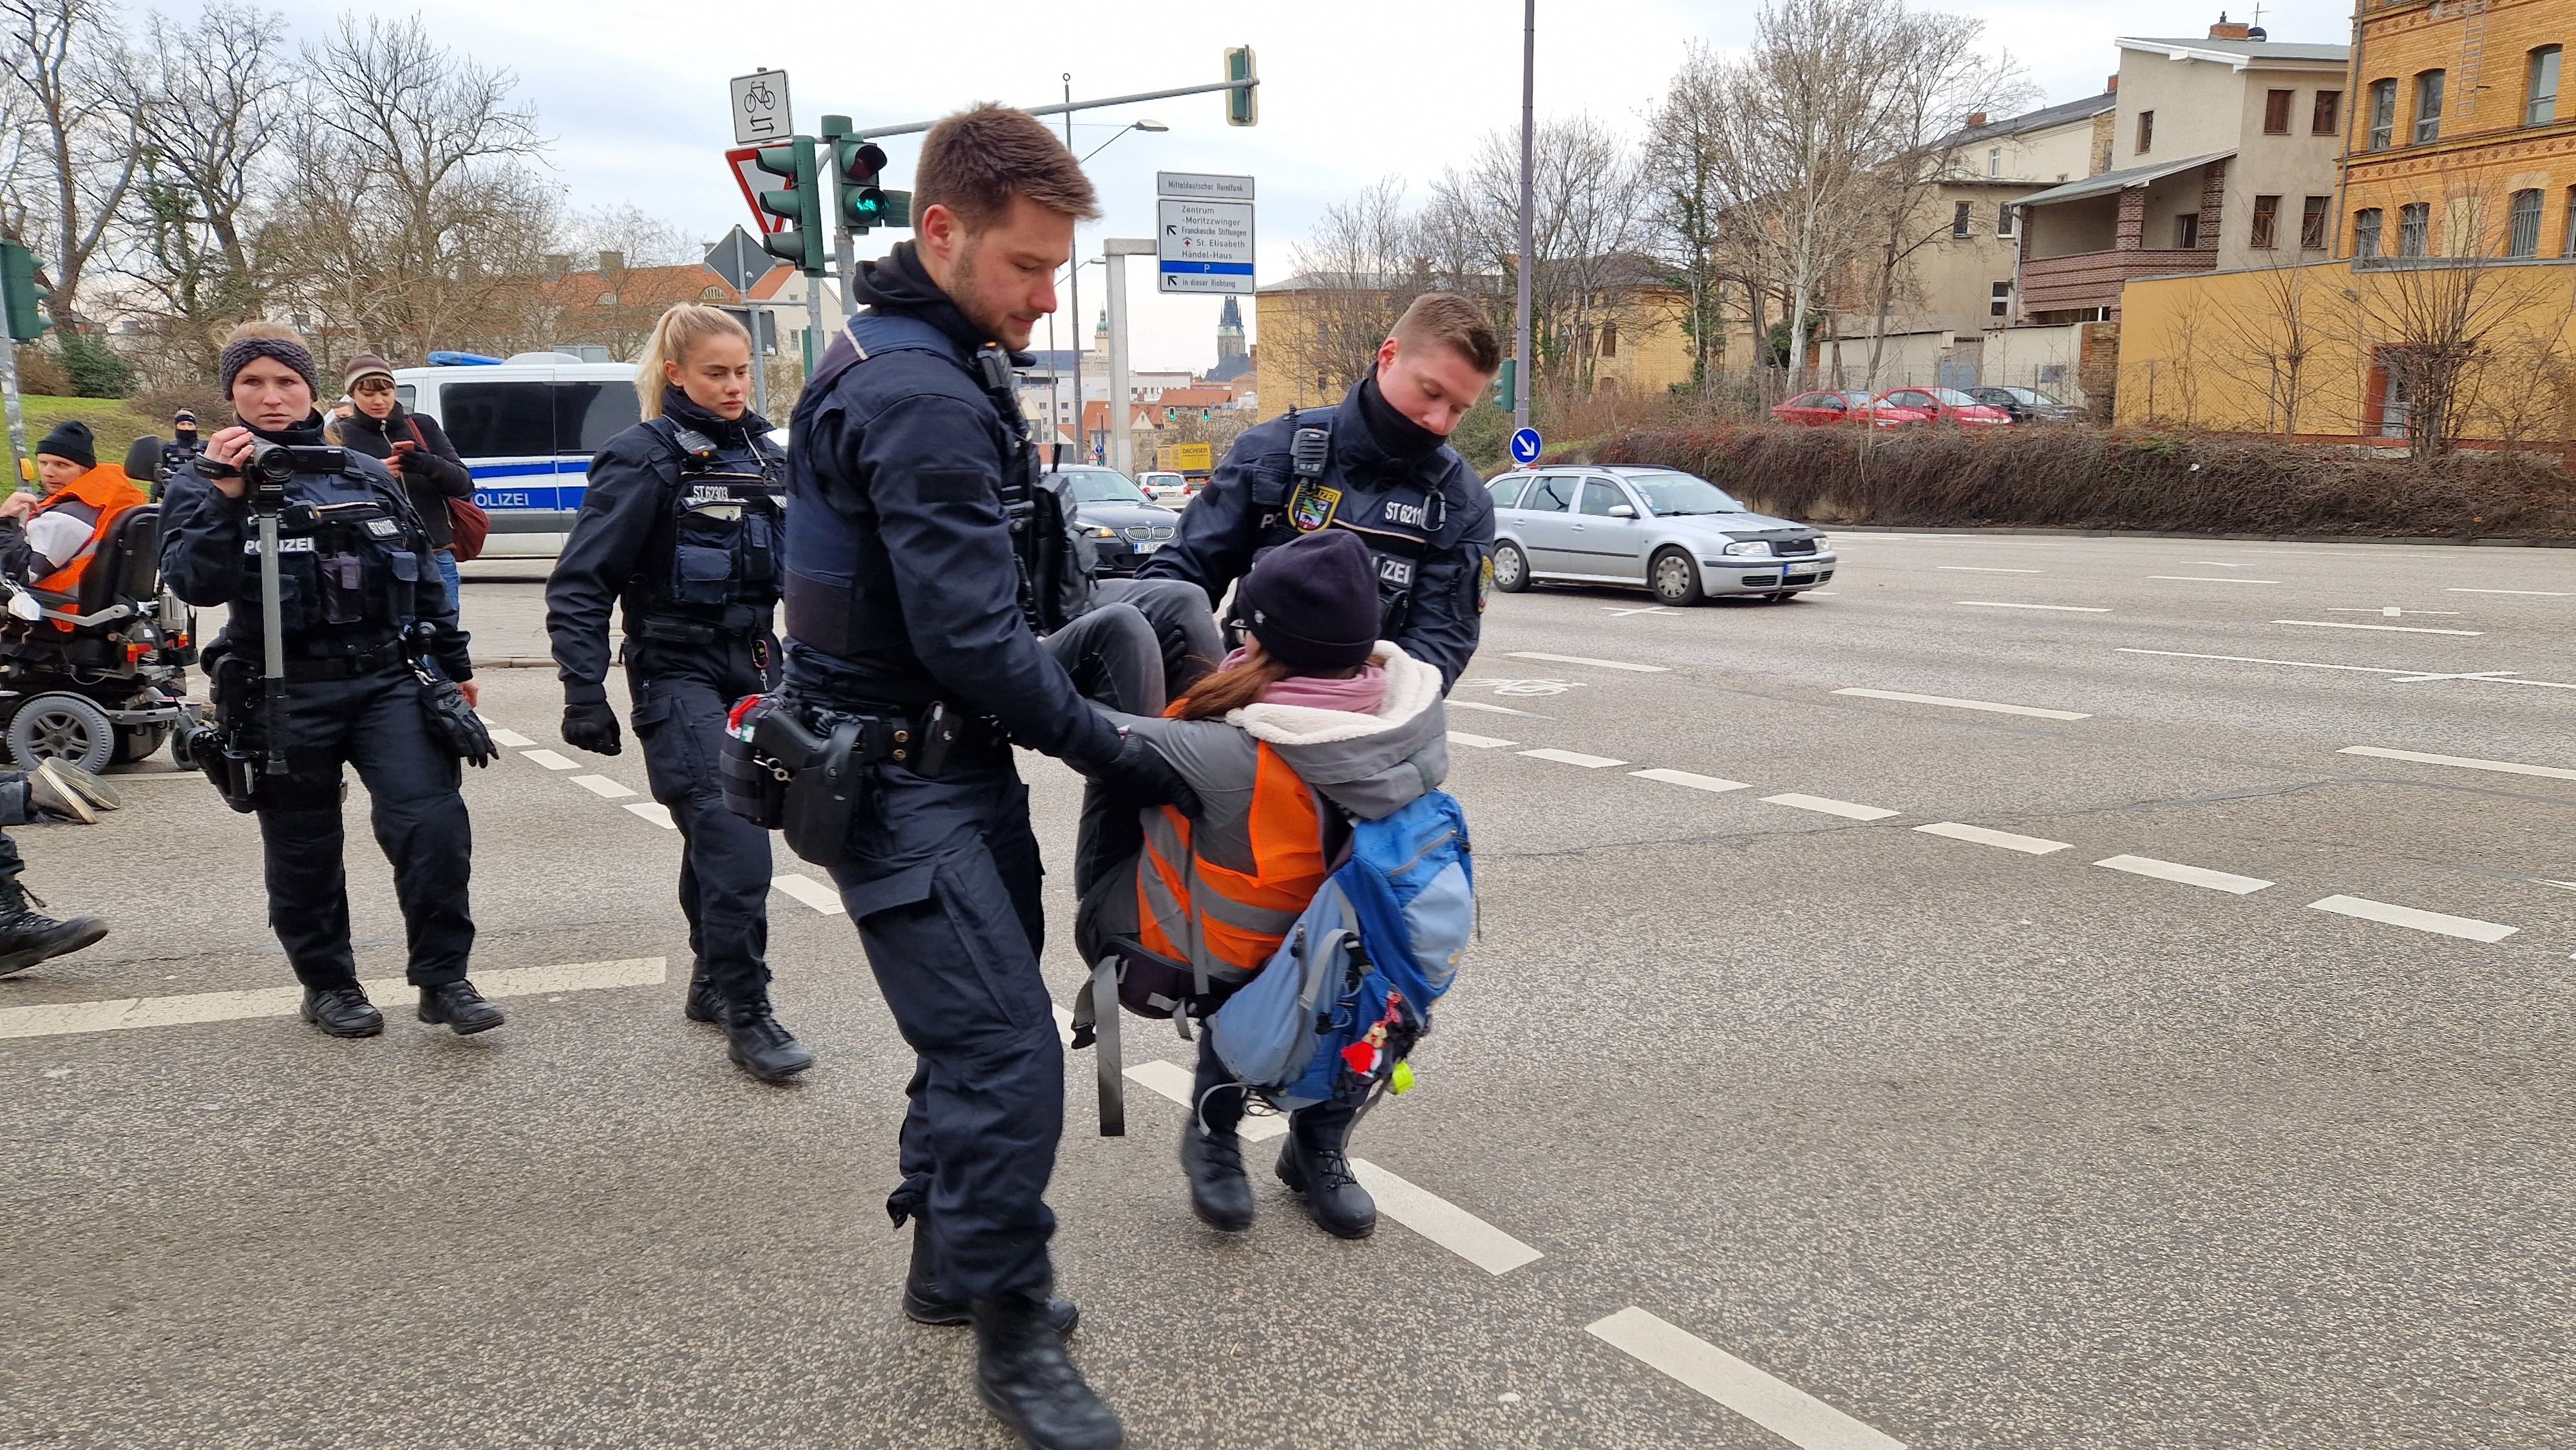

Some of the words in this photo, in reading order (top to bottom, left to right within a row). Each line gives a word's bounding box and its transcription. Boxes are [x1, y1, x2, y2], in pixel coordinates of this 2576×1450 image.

[1168, 180, 1213, 191] Mitteldeutscher
[1217, 184, 1244, 192] Rundfunk
[1181, 205, 1215, 214] Zentrum
[1182, 217, 1240, 227] -Moritzzwinger
[1181, 227, 1216, 236] Franckesche
[1218, 228, 1247, 238] Stiftungen
[1209, 239, 1245, 248] Elisabeth
[1182, 250, 1233, 259] Händel-Haus
[1204, 264, 1211, 274] P
[1211, 279, 1236, 289] Richtung
[693, 485, 705, 498] ST
[705, 486, 728, 499] 62303
[474, 493, 529, 507] OLIZEI
[1385, 502, 1401, 520] ST
[1399, 504, 1423, 525] 6211
[244, 537, 313, 553] PIZEI
